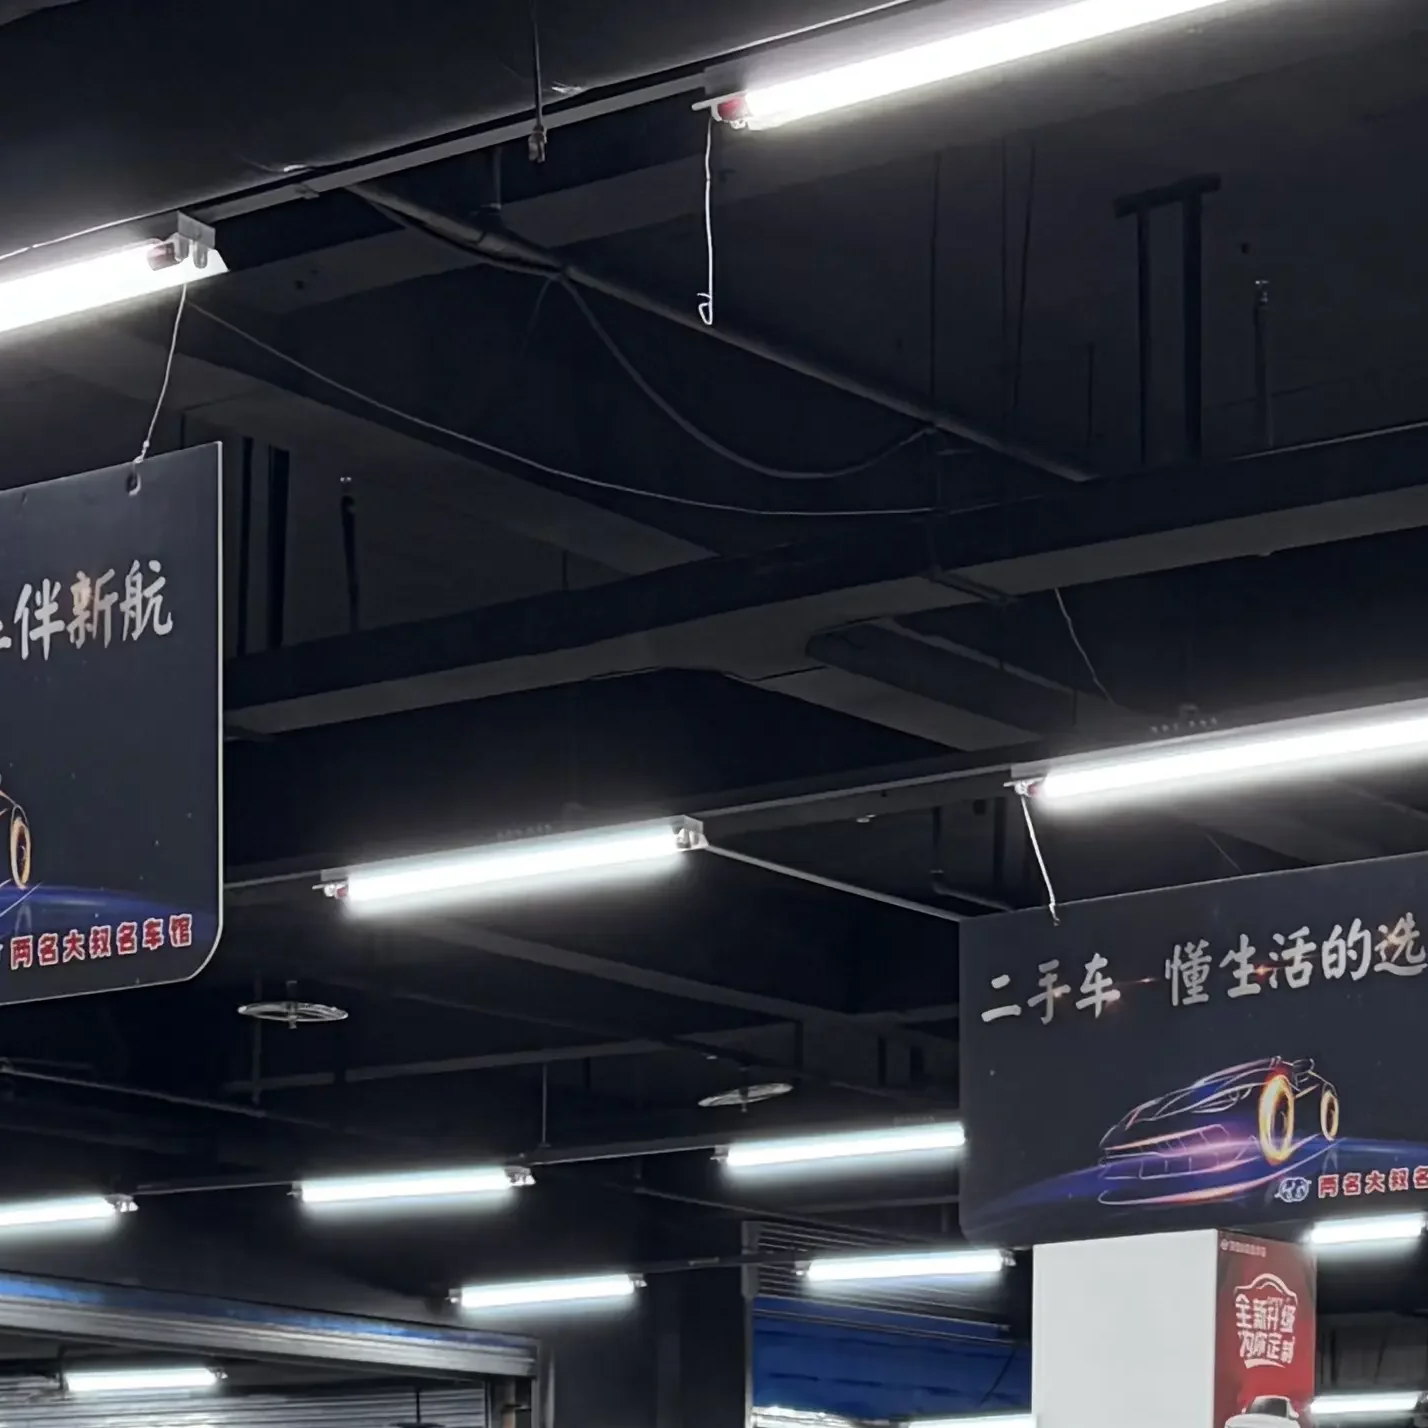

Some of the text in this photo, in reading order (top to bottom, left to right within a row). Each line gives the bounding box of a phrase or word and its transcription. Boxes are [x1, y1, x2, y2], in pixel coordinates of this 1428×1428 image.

[11, 914, 192, 970] 两名大叔名车馆
[982, 953, 1120, 1024] 二手车
